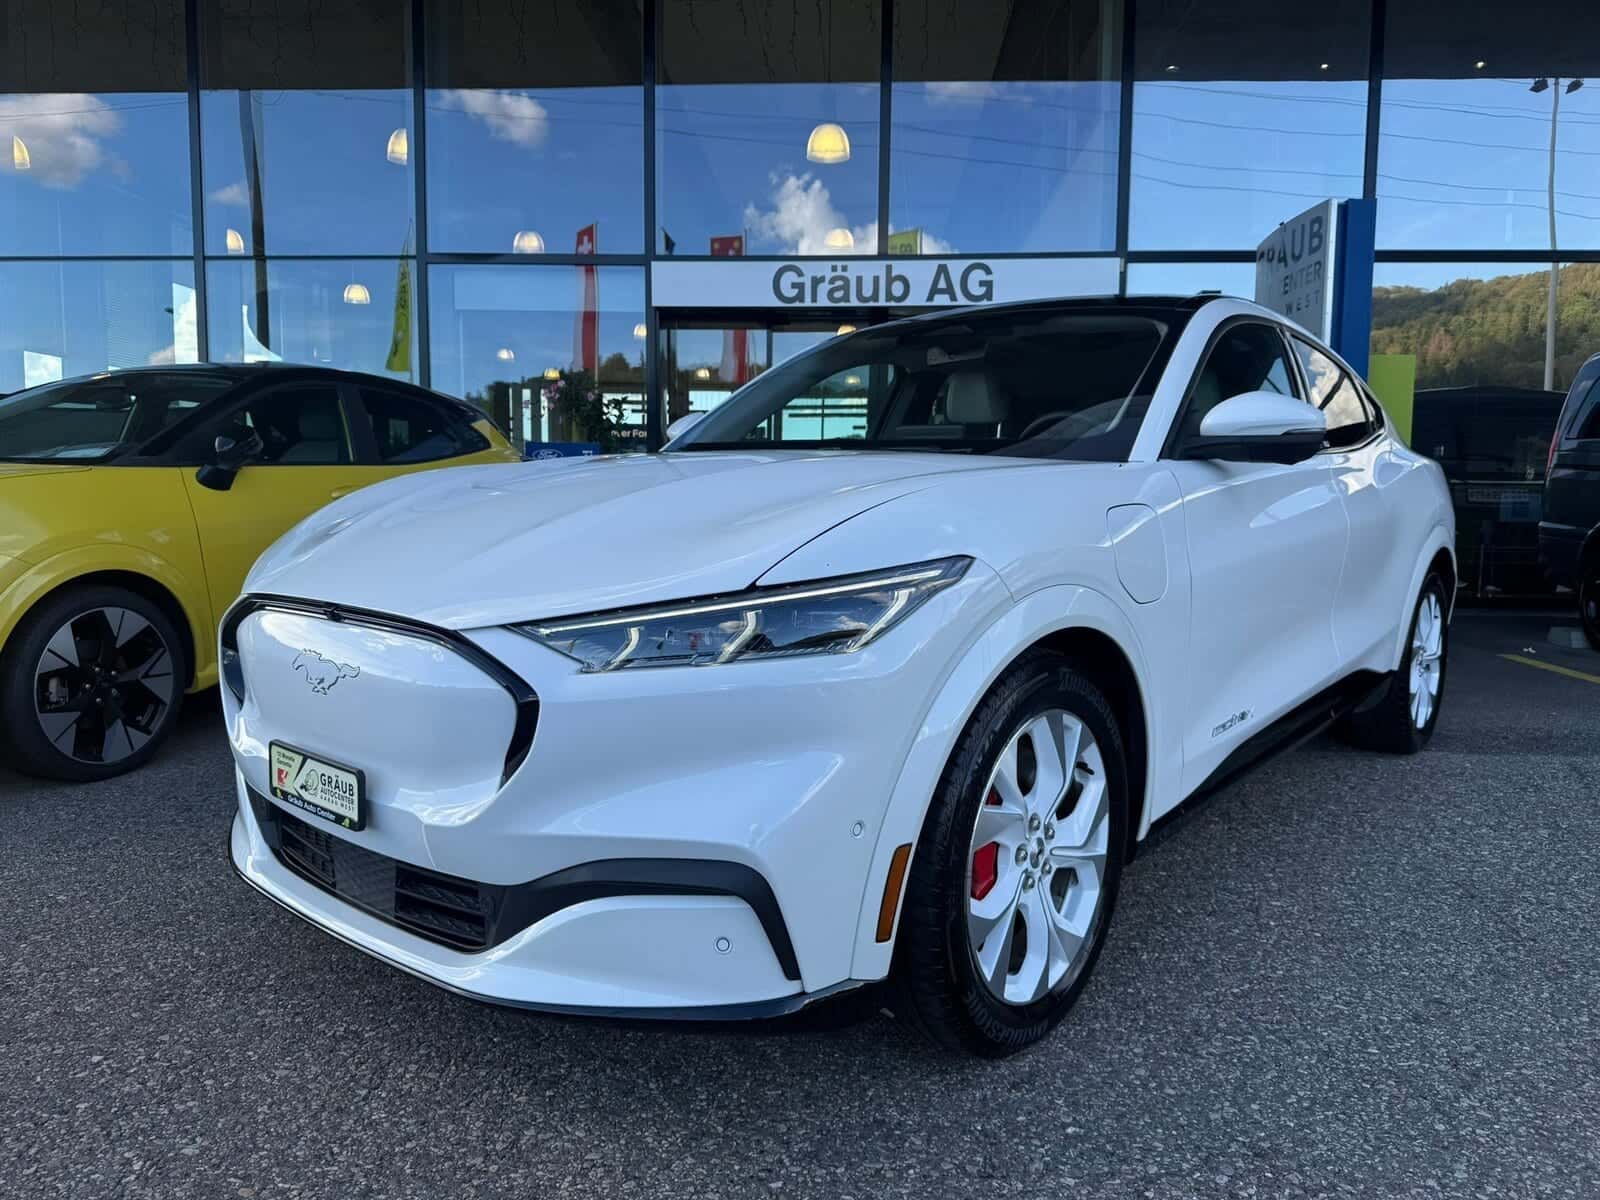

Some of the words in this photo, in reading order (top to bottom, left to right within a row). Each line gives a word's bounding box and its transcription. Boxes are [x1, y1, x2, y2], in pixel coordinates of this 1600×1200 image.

[772, 264, 911, 304] Gräub
[926, 262, 993, 303] AG
[320, 773, 354, 797] GRÄUB
[320, 787, 354, 805] AUTOCENTER
